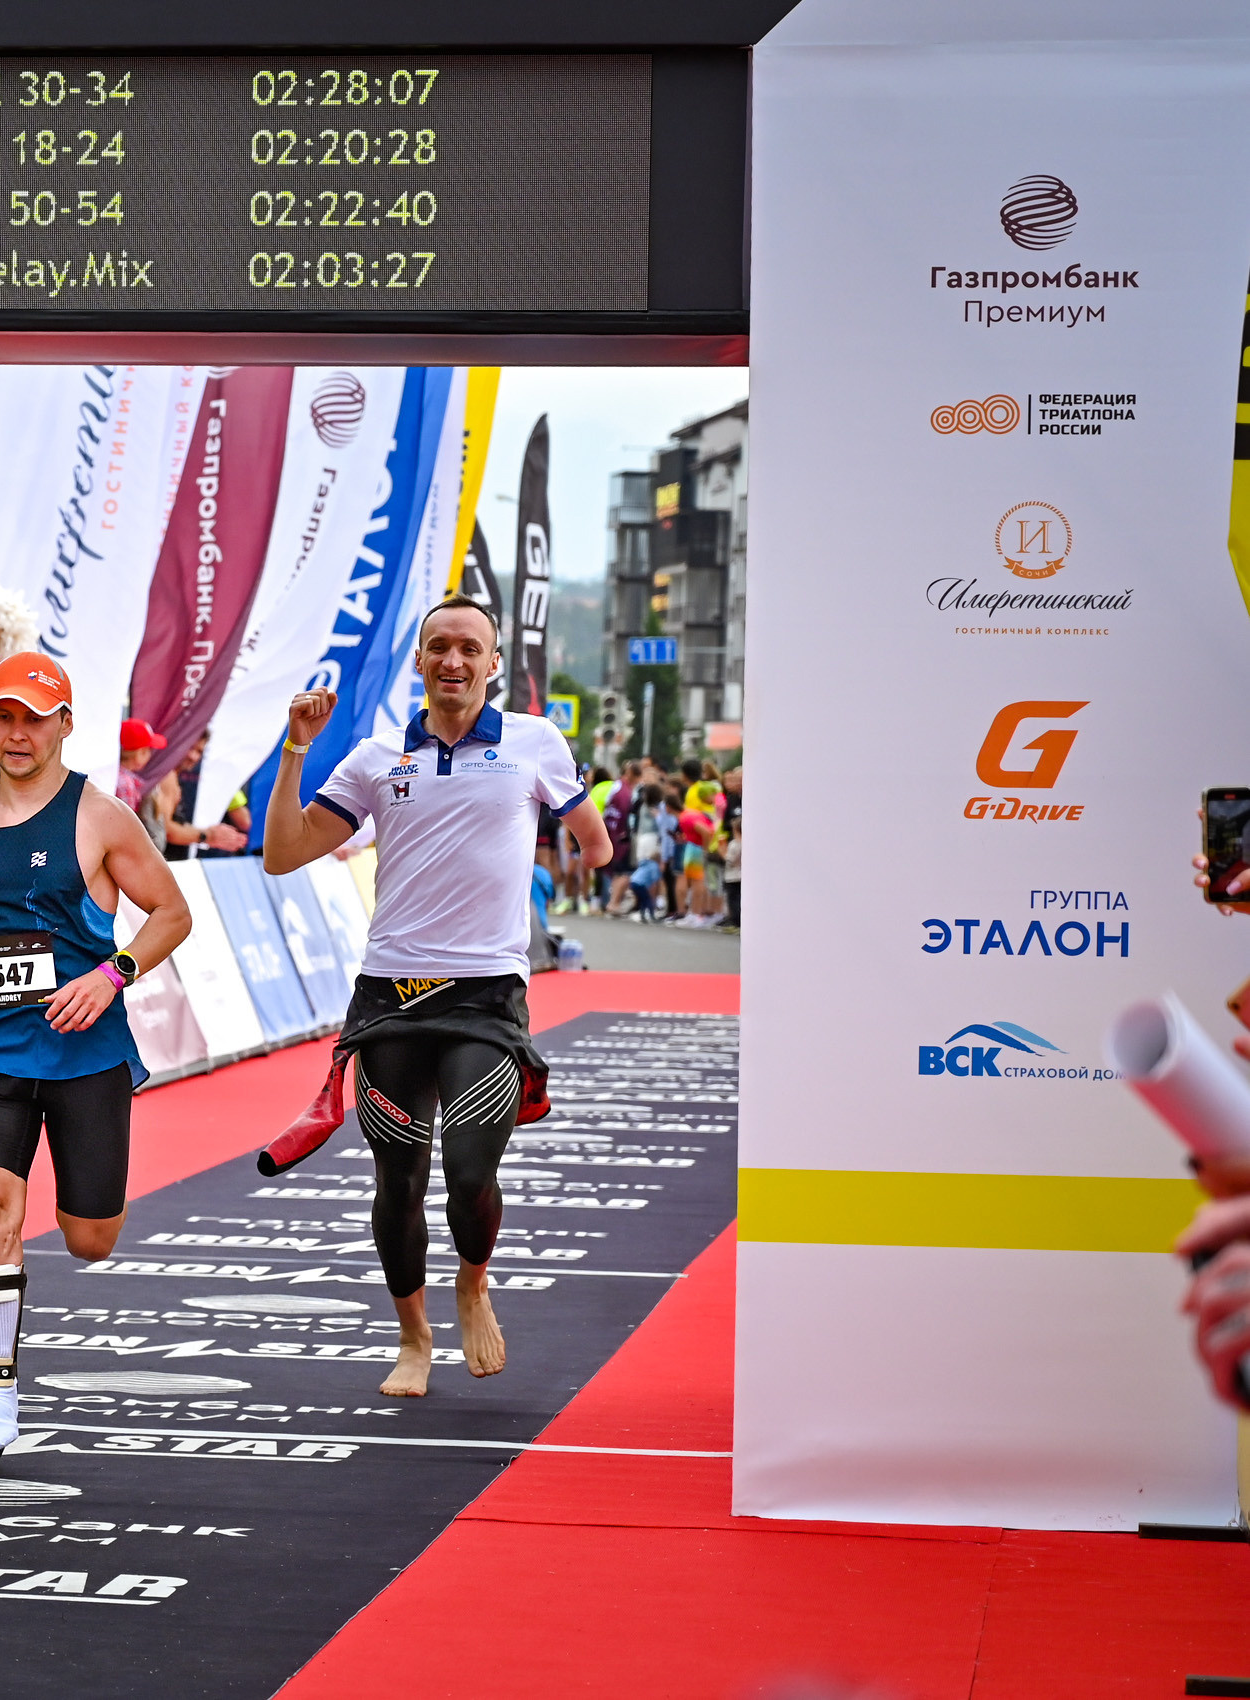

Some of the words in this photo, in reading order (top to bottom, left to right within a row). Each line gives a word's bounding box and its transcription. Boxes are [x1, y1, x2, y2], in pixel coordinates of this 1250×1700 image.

[19, 71, 134, 107] 30-34
[251, 70, 439, 106] 02:28:07
[12, 131, 125, 165] 18-24
[251, 129, 437, 165] 02:20:28
[9, 191, 124, 226] 50-54
[250, 190, 437, 226] 02:22:40
[249, 252, 435, 288] 02:03:27
[930, 263, 1140, 294] Газпромбанк
[964, 300, 1106, 329] Премиум
[1039, 393, 1136, 407] ФЕДЕРАЦИЯ
[1039, 408, 1136, 421] ТРИАТЛОНА
[1039, 423, 1102, 436] РОССИИ
[101, 365, 136, 531] ГОСТИНИЧ
[1018, 568, 1050, 579] СОЧИ
[926, 577, 1135, 618] Имеретинский
[955, 625, 1042, 636] ГОСТИНИЧНЫЙ
[1047, 627, 1110, 636] КОМПЛЕКС
[461, 762, 519, 770] ОРТО-СПОРТ
[1030, 889, 1130, 912] ГРУППА
[921, 918, 1130, 958] ЭТАЛОН
[918, 1045, 1003, 1078] ВСК
[1004, 1066, 1089, 1080] СТРАХОВОЙ
[147, 1233, 321, 1247] IRON
[85, 1261, 271, 1275] IRON
[95, 1435, 361, 1458] STAR
